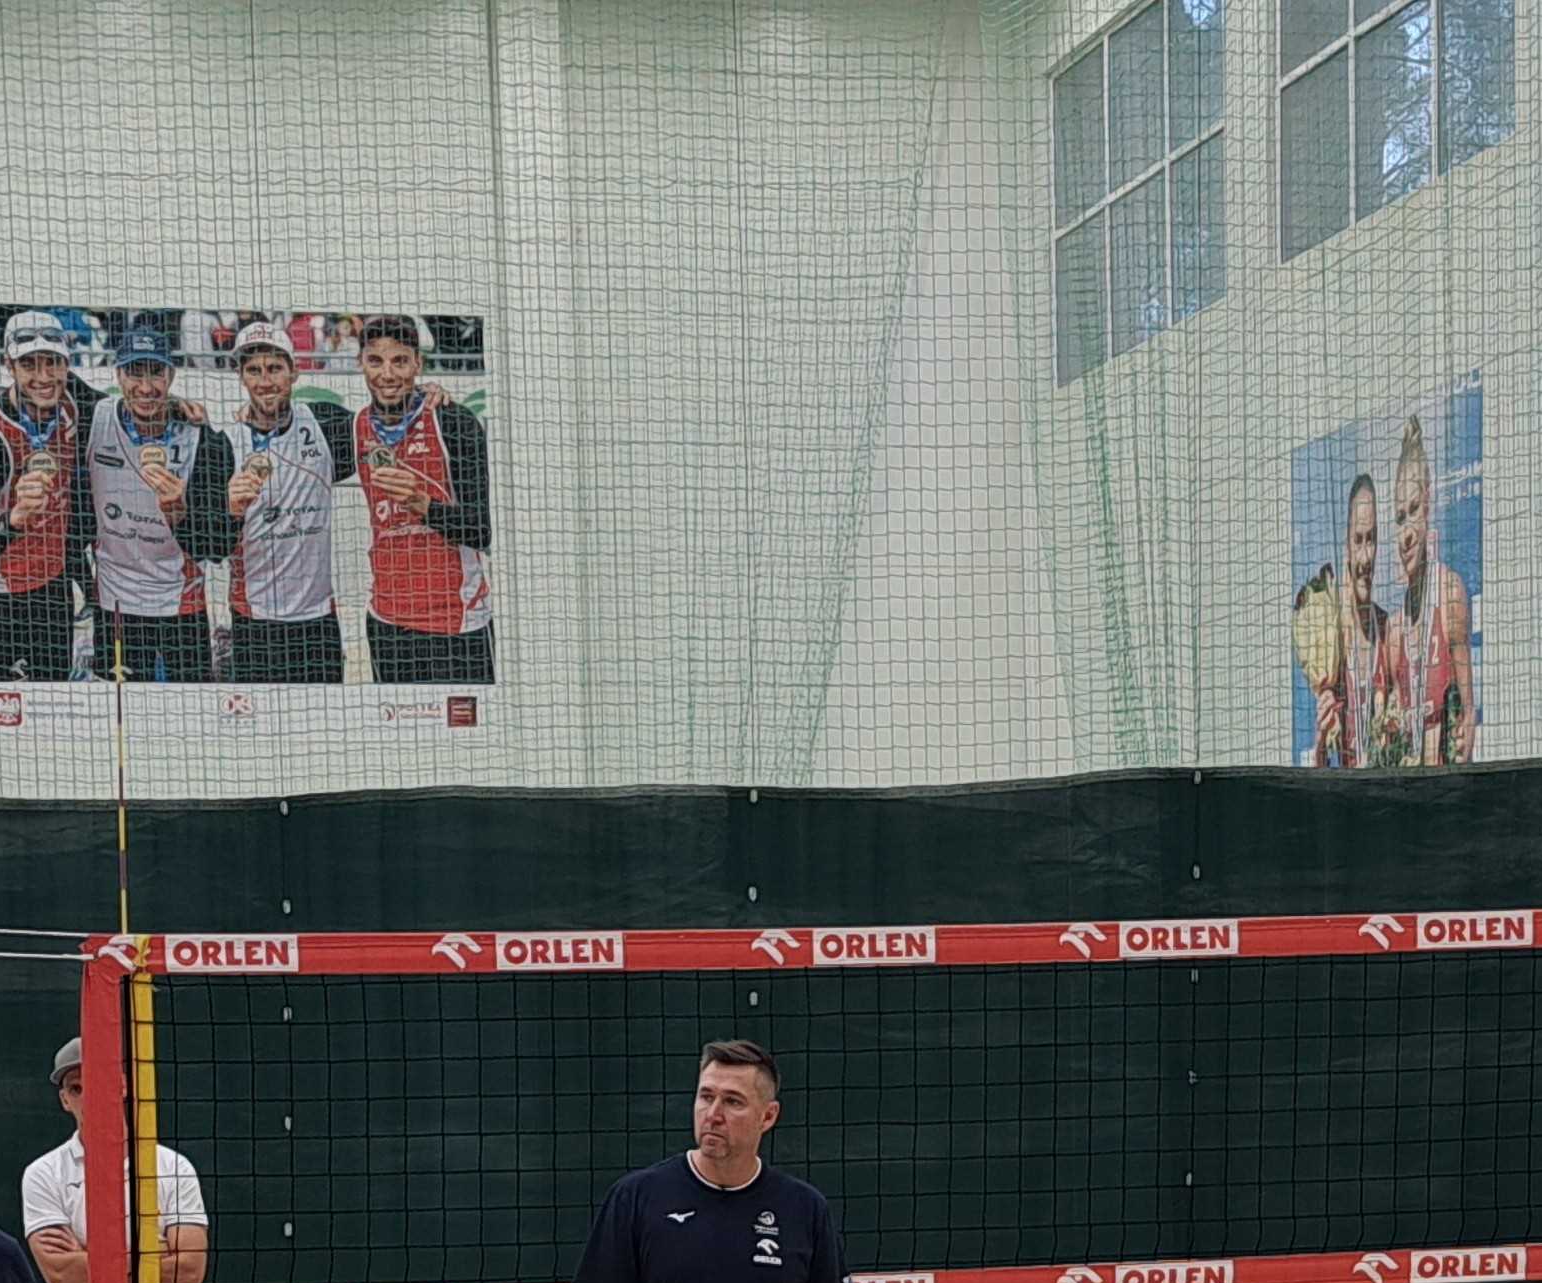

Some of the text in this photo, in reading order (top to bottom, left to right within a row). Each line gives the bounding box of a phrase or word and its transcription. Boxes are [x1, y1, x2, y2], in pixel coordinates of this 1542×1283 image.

[299, 427, 314, 446] 2
[171, 444, 182, 464] 1
[171, 940, 290, 969] ORLEN
[500, 939, 617, 966] ORLEN
[820, 932, 929, 961] ORLEN
[1125, 926, 1232, 953] ORLEN
[1421, 916, 1528, 945] ORLEN
[1417, 1252, 1520, 1280] ORLEN
